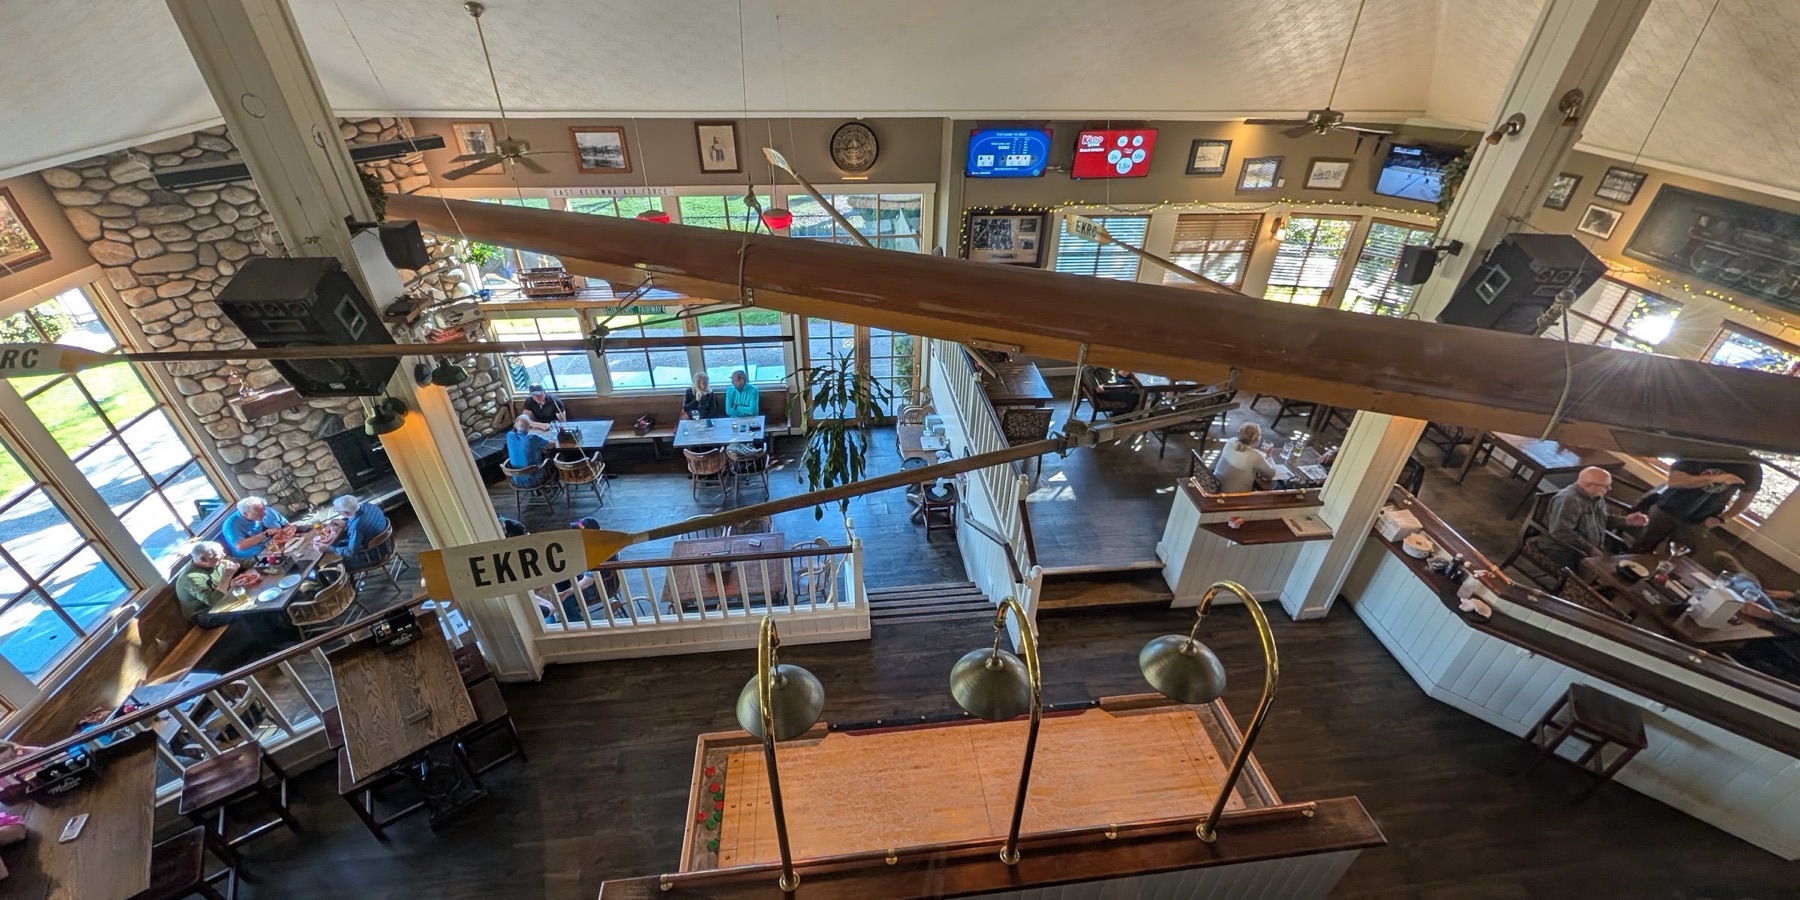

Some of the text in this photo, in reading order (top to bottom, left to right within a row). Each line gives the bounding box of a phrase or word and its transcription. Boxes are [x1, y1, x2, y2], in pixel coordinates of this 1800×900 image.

[553, 189, 573, 197] EAST
[642, 188, 668, 196] FORCE
[1075, 219, 1098, 239] EKRC
[468, 542, 567, 588] EKRC
